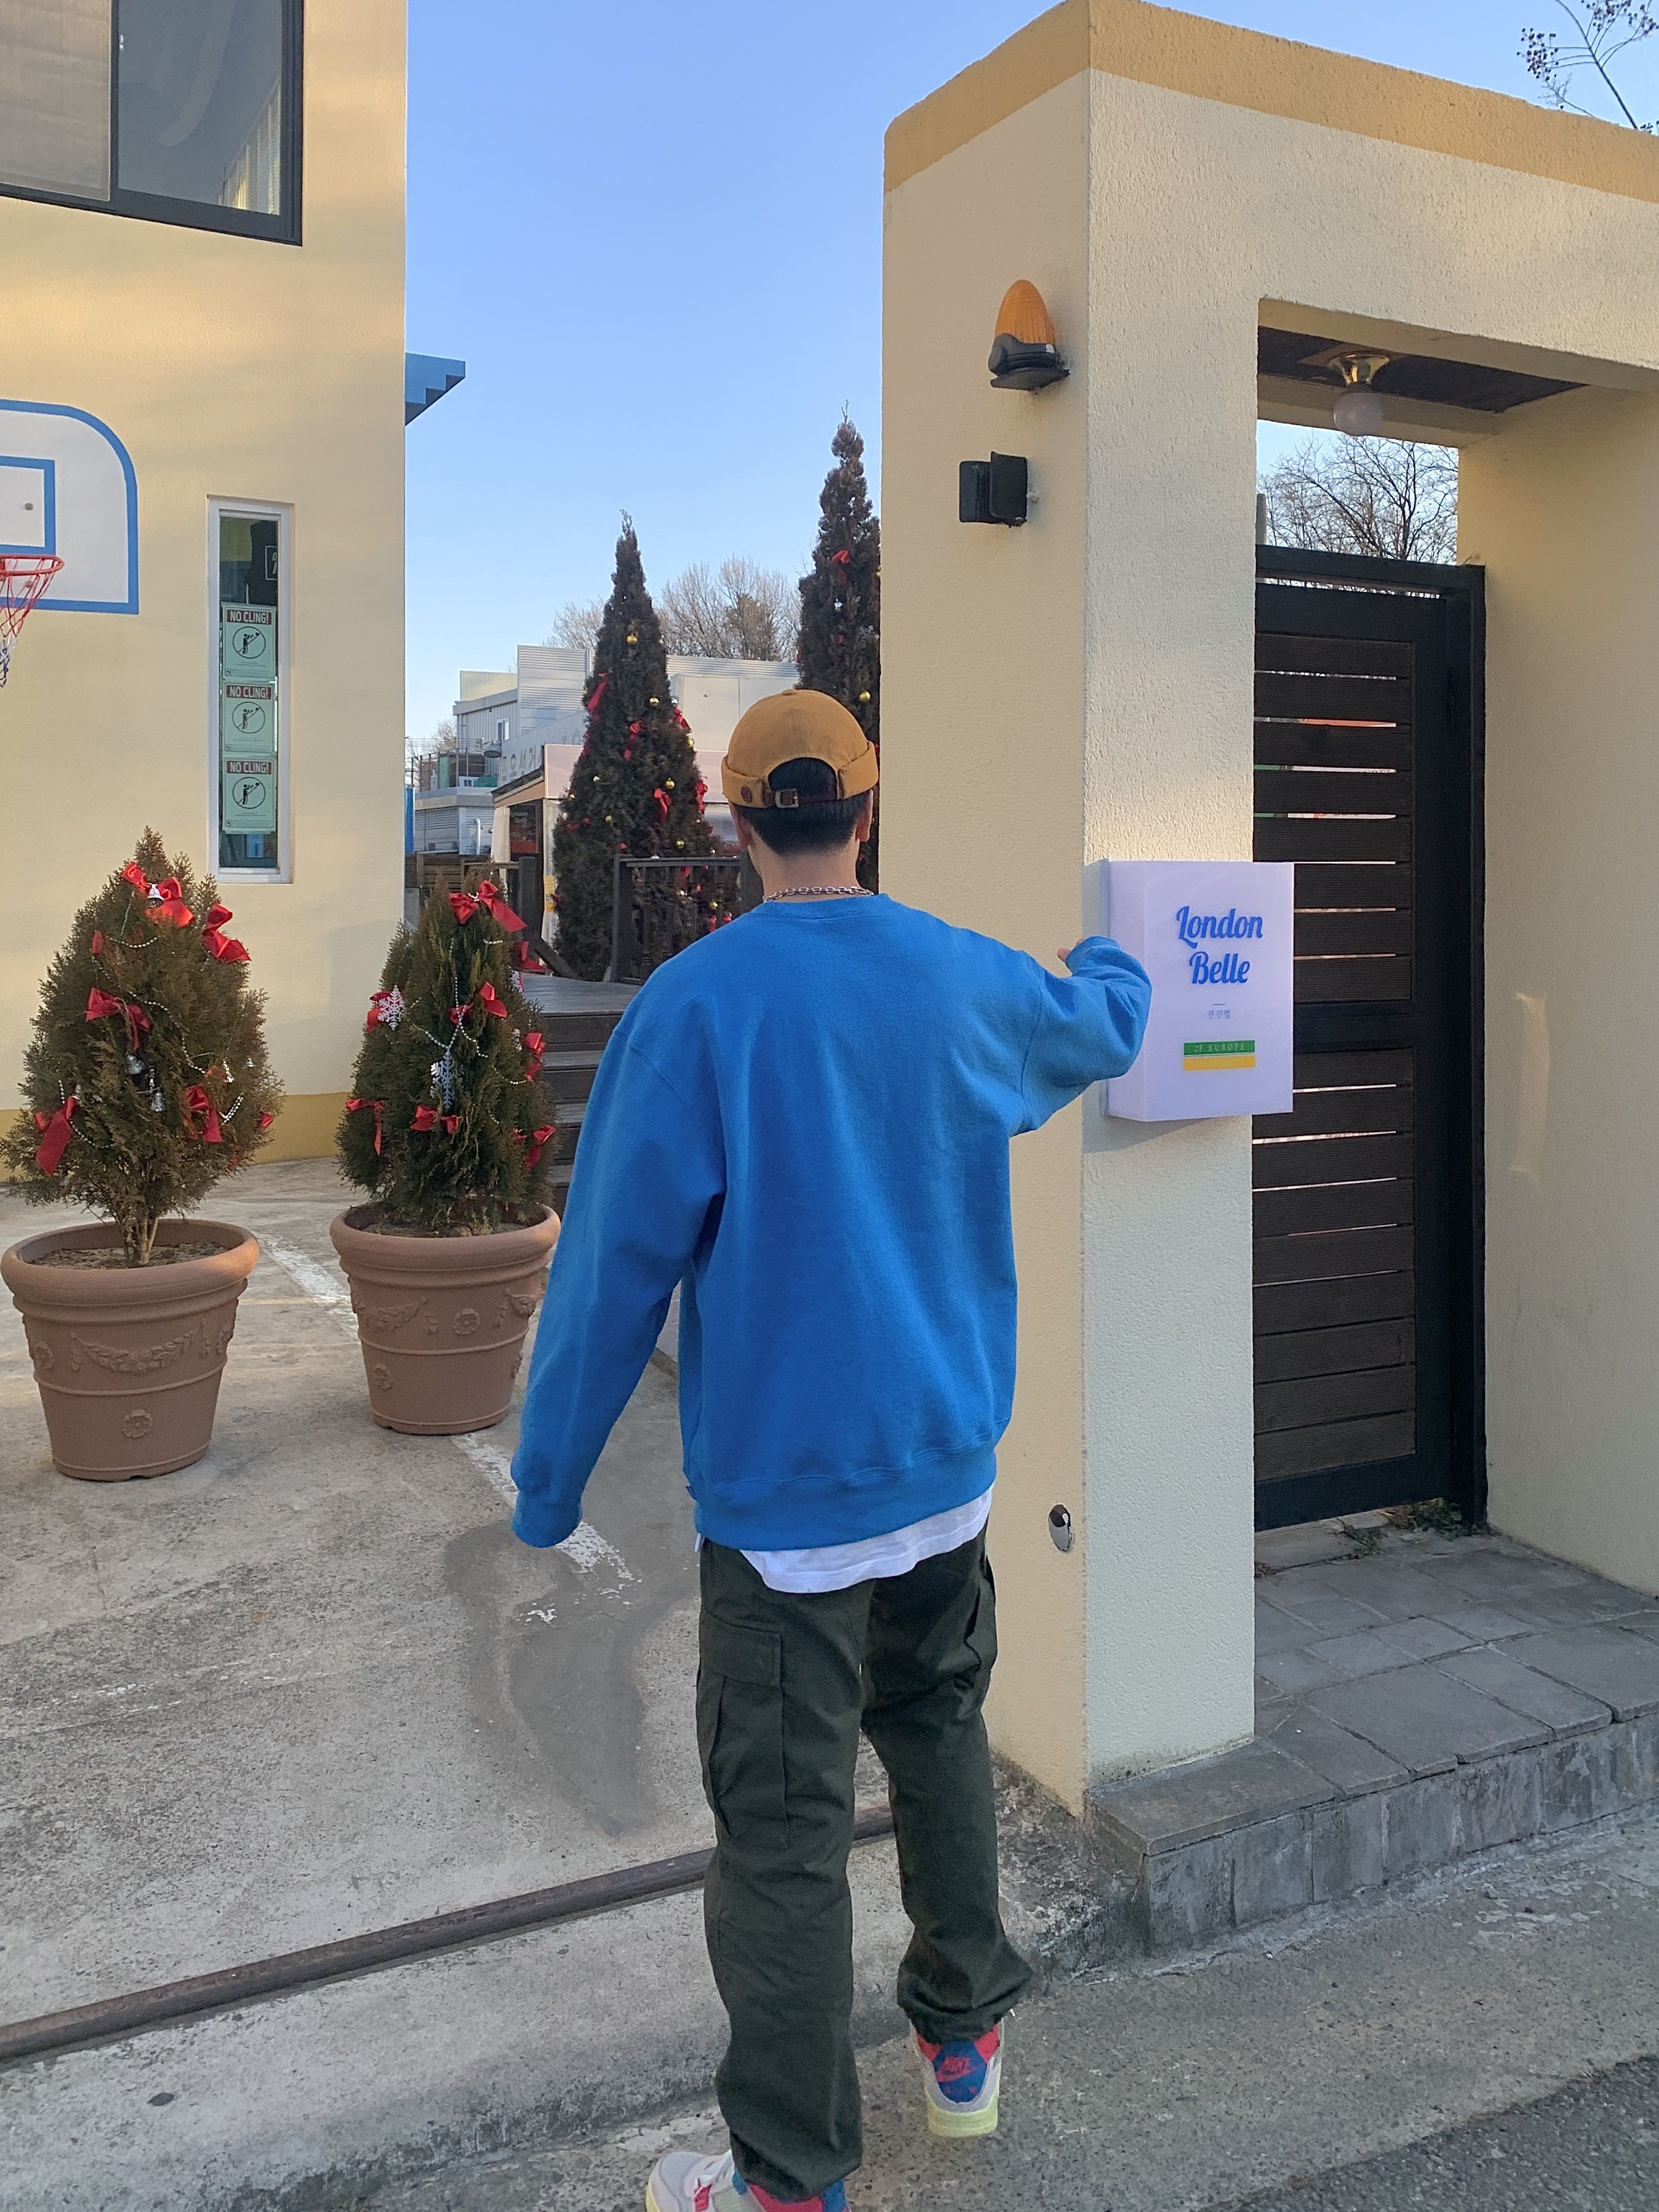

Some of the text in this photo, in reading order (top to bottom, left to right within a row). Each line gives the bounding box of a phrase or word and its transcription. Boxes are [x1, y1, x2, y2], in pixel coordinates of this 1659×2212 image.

[230, 610, 269, 624] NO CLING!
[229, 686, 269, 699] NO CLING!
[230, 761, 269, 774] NO CLING!
[1175, 905, 1264, 949] London
[1189, 950, 1251, 985] Belle
